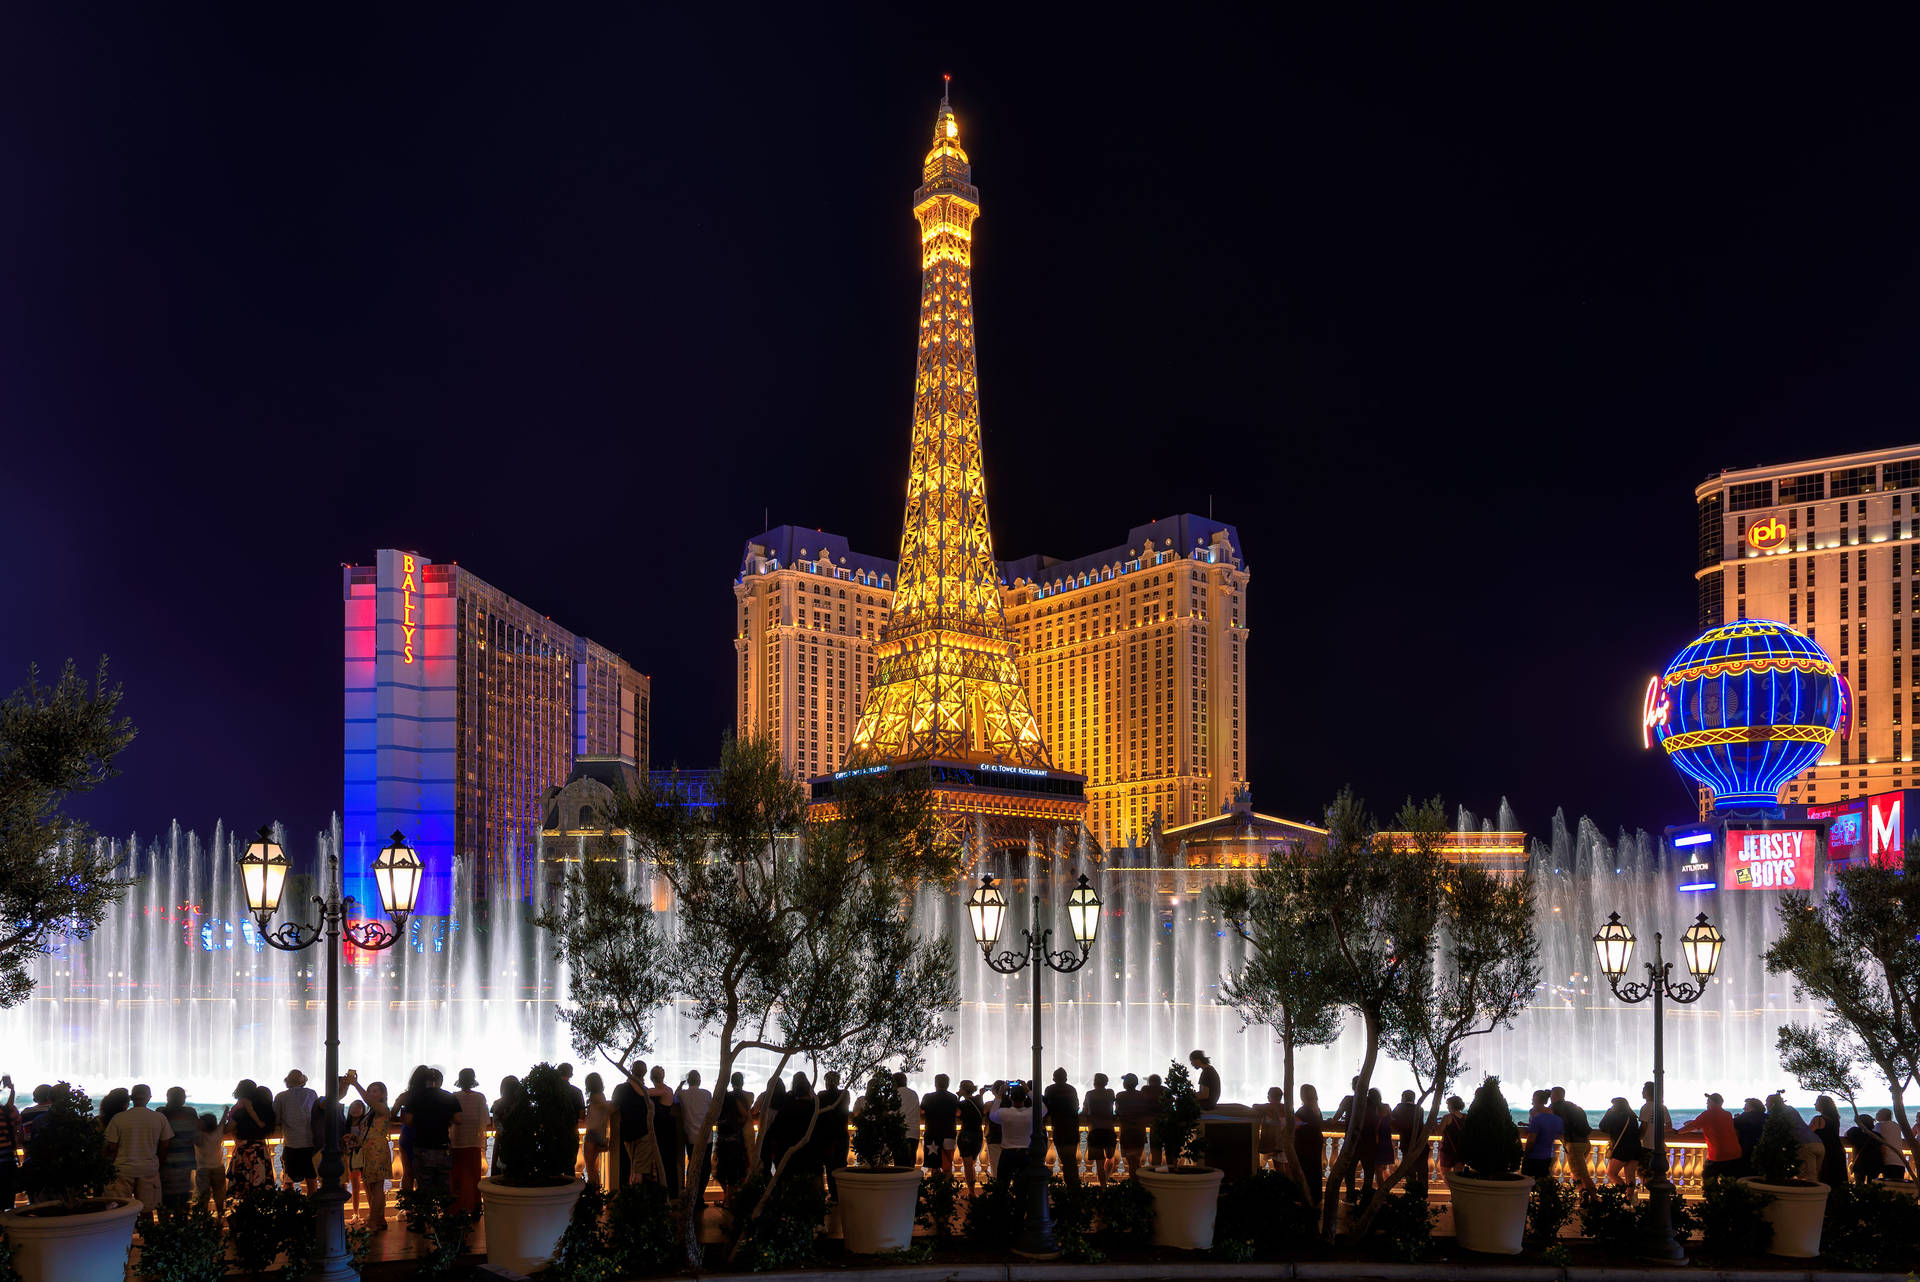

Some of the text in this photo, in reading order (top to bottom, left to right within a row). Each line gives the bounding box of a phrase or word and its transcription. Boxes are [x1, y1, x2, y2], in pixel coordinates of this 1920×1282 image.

[1753, 517, 1786, 545] ph
[401, 554, 416, 664] BALLYS
[1738, 832, 1803, 862] JERSEY
[1750, 859, 1796, 888] BOYS
